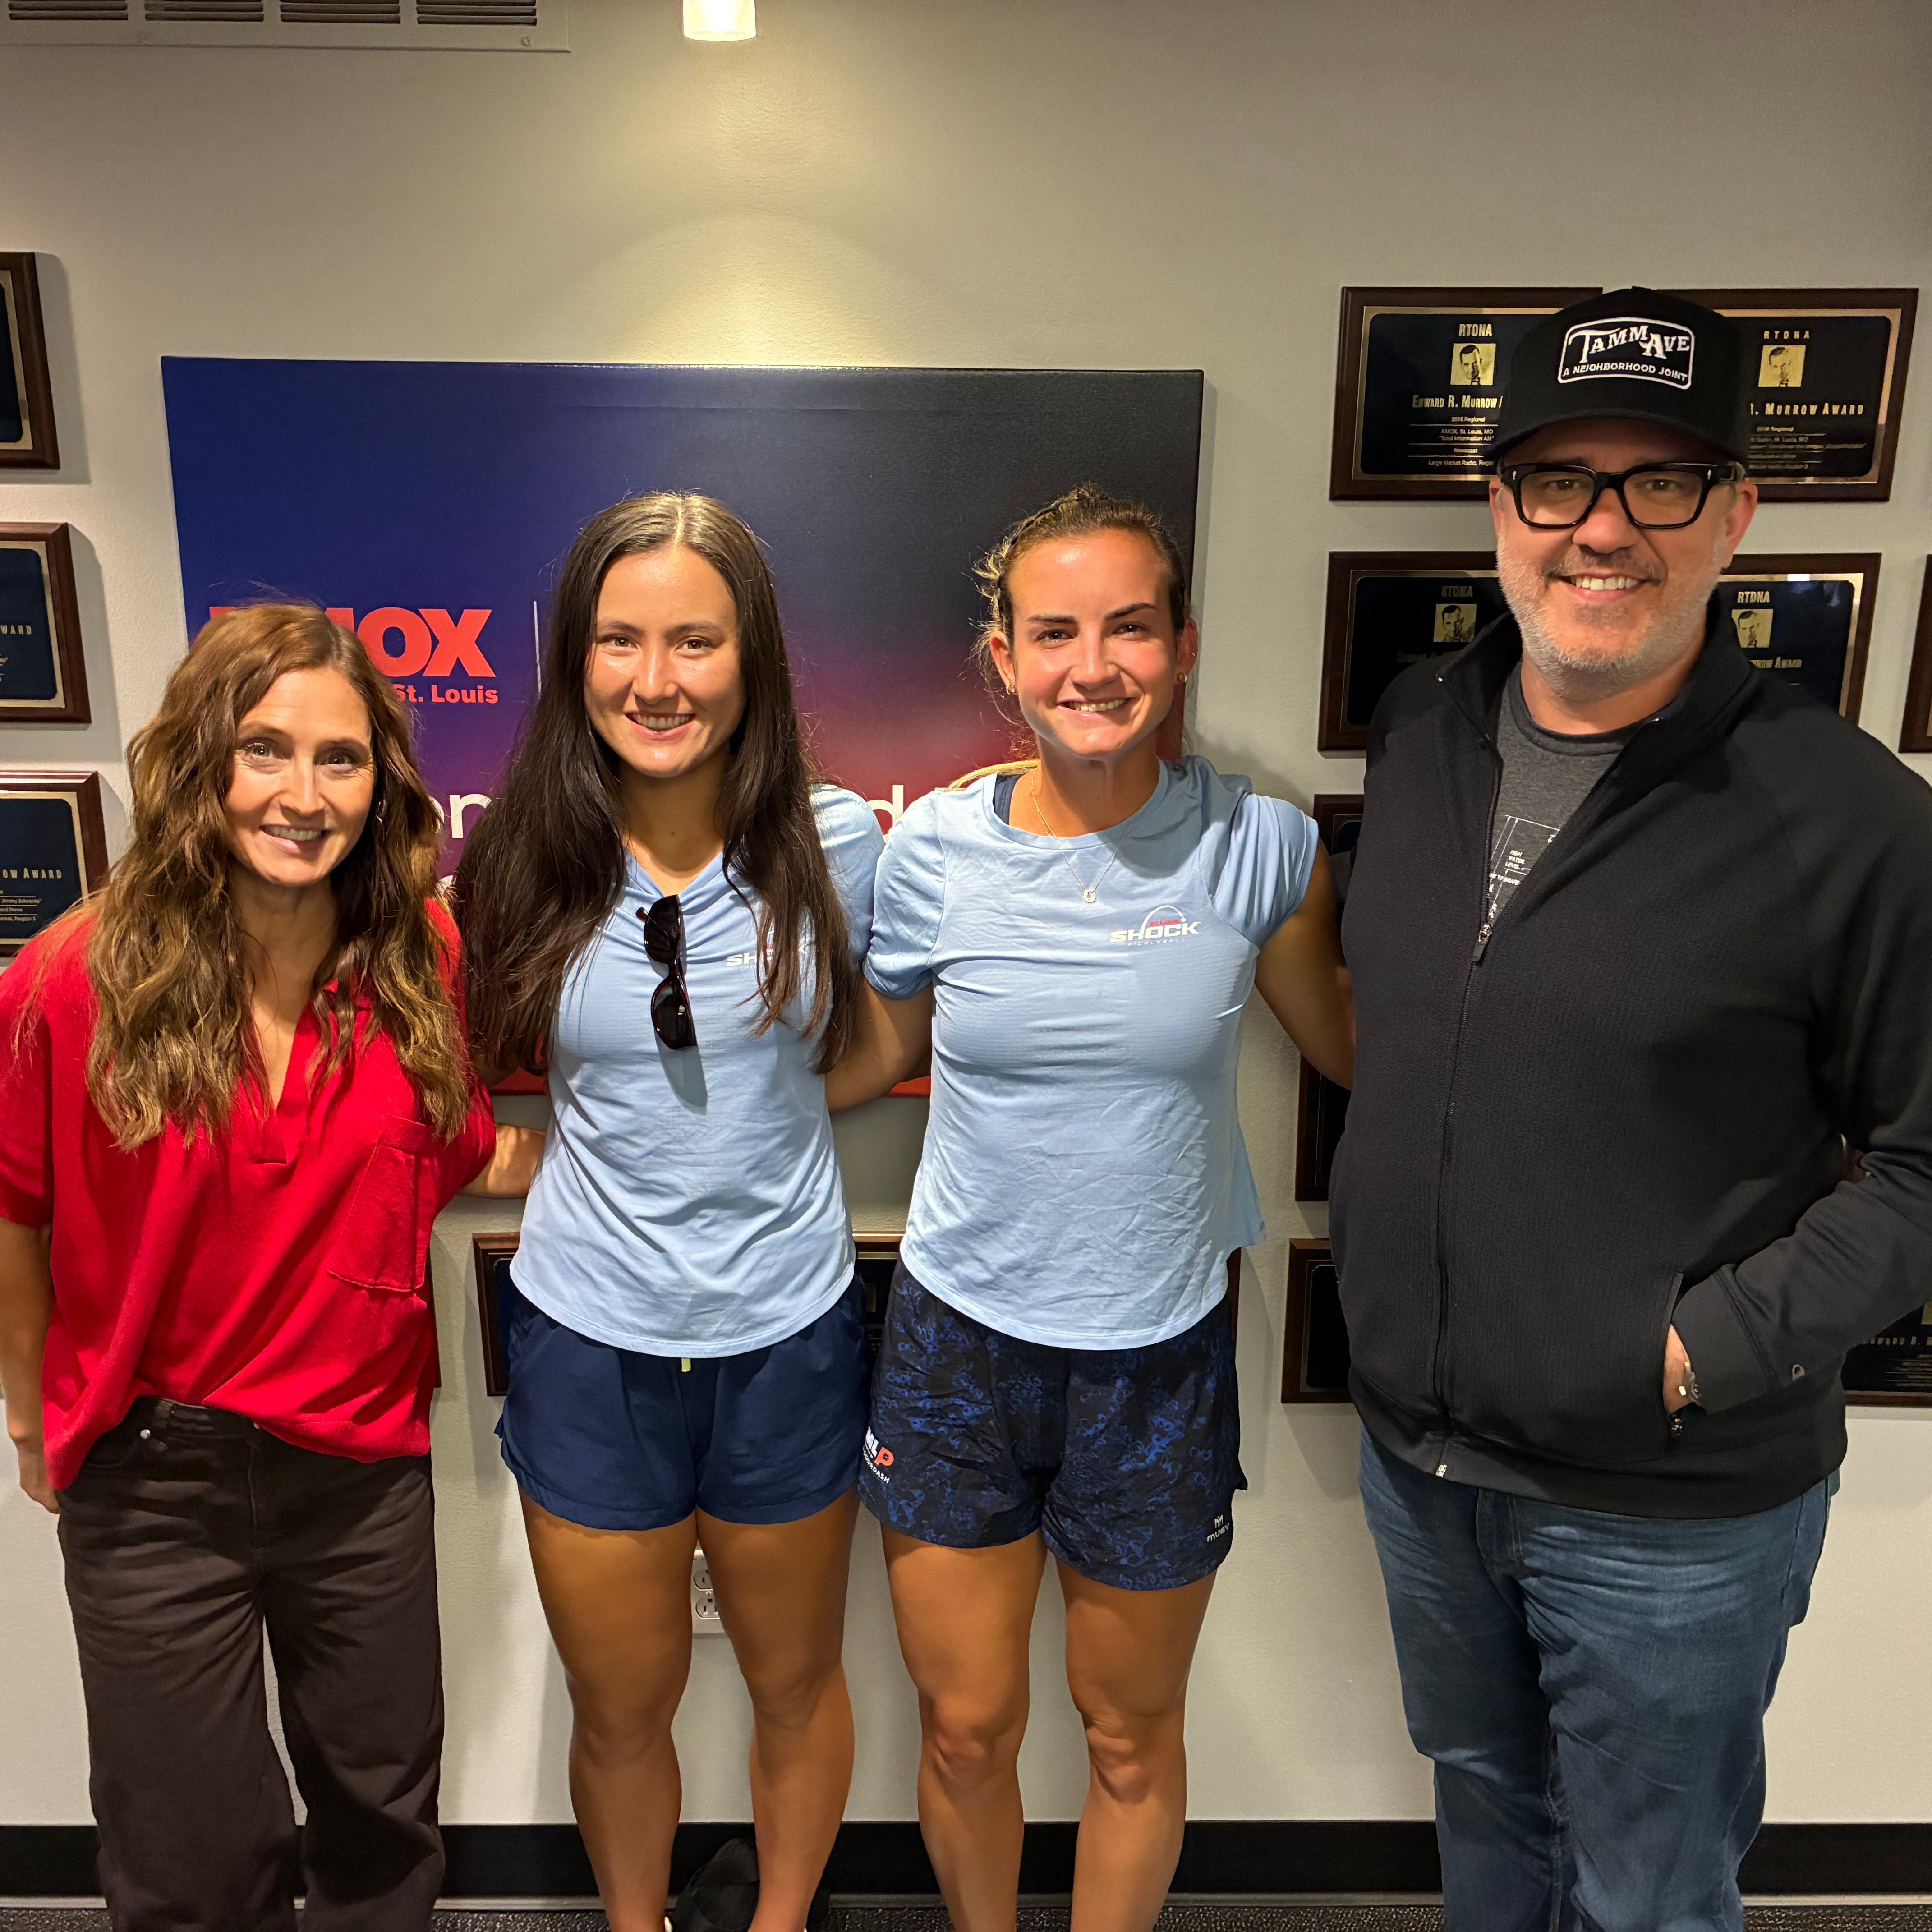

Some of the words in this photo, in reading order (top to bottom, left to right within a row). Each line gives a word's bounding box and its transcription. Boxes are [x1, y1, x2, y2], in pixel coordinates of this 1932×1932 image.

[1458, 323, 1492, 336] RTDNA
[1638, 332, 1691, 359] AVE
[1562, 368, 1569, 377] A
[1573, 362, 1656, 375] NEIGHBORHOOD
[1658, 367, 1688, 382] JOINT
[1448, 395, 1458, 408] R.
[1462, 395, 1497, 408] MURROW
[1737, 591, 1770, 603] RTDNA
[0, 625, 32, 635] WARD
[431, 684, 498, 704] Louis
[23, 868, 62, 879] AWARD
[1110, 921, 1201, 943] SHOCK
